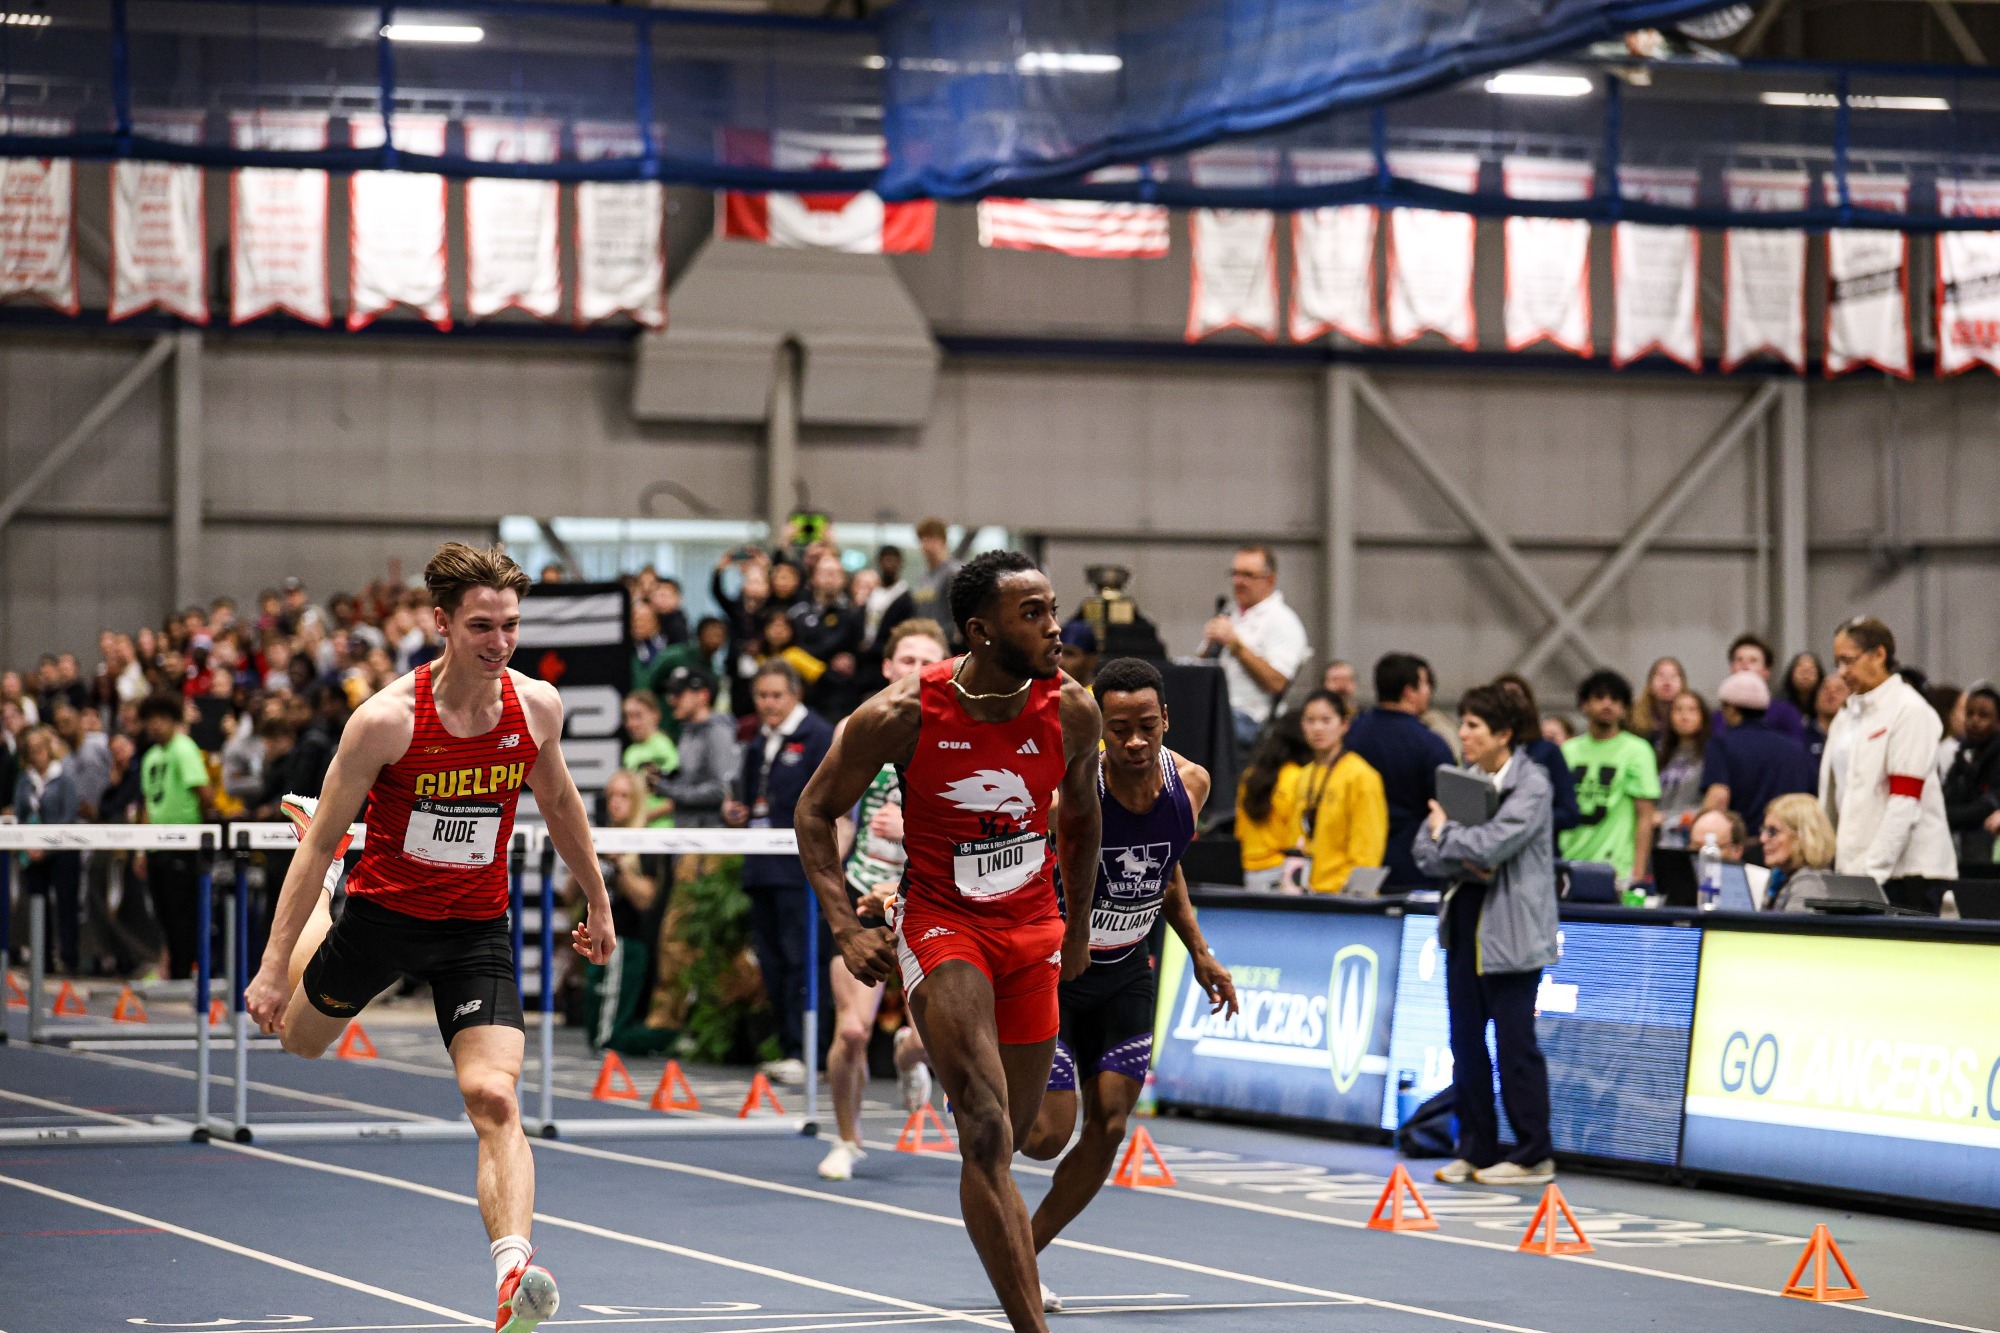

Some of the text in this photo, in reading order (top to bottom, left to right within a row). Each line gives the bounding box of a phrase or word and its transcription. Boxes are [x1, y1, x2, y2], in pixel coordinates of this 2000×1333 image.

[938, 741, 971, 750] OUA
[414, 762, 526, 798] GUELPH
[435, 804, 449, 813] TRACK
[432, 818, 478, 843] RUDE
[974, 843, 989, 851] TRACK
[977, 845, 1024, 878] LINDO
[1110, 880, 1161, 892] MUSTANGS
